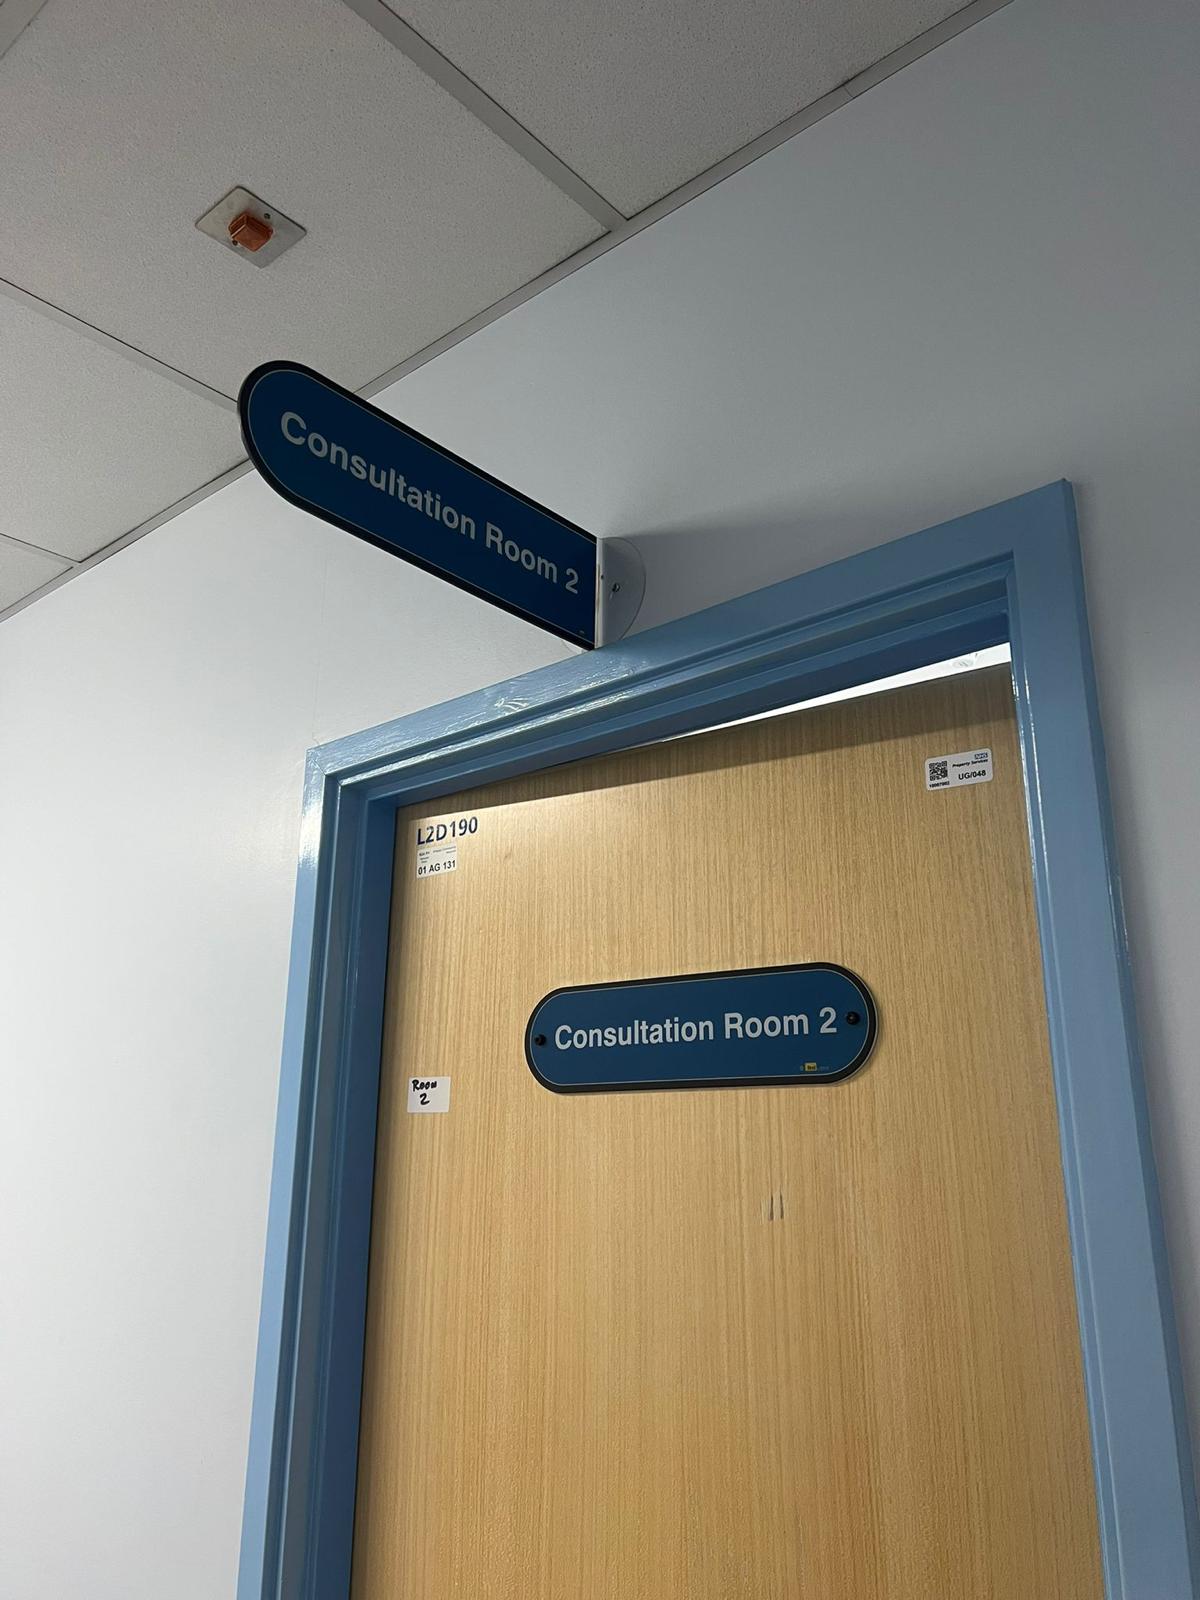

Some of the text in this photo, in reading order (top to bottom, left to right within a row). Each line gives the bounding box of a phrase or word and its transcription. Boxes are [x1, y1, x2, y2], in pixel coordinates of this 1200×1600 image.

[280, 411, 580, 594] Consultation Room 2
[958, 769, 987, 780] UG/048
[417, 816, 478, 845] L2D190
[418, 860, 456, 875] 01 AG 131
[554, 1006, 838, 1050] Consultation Room 2
[420, 1092, 430, 1105] 2
